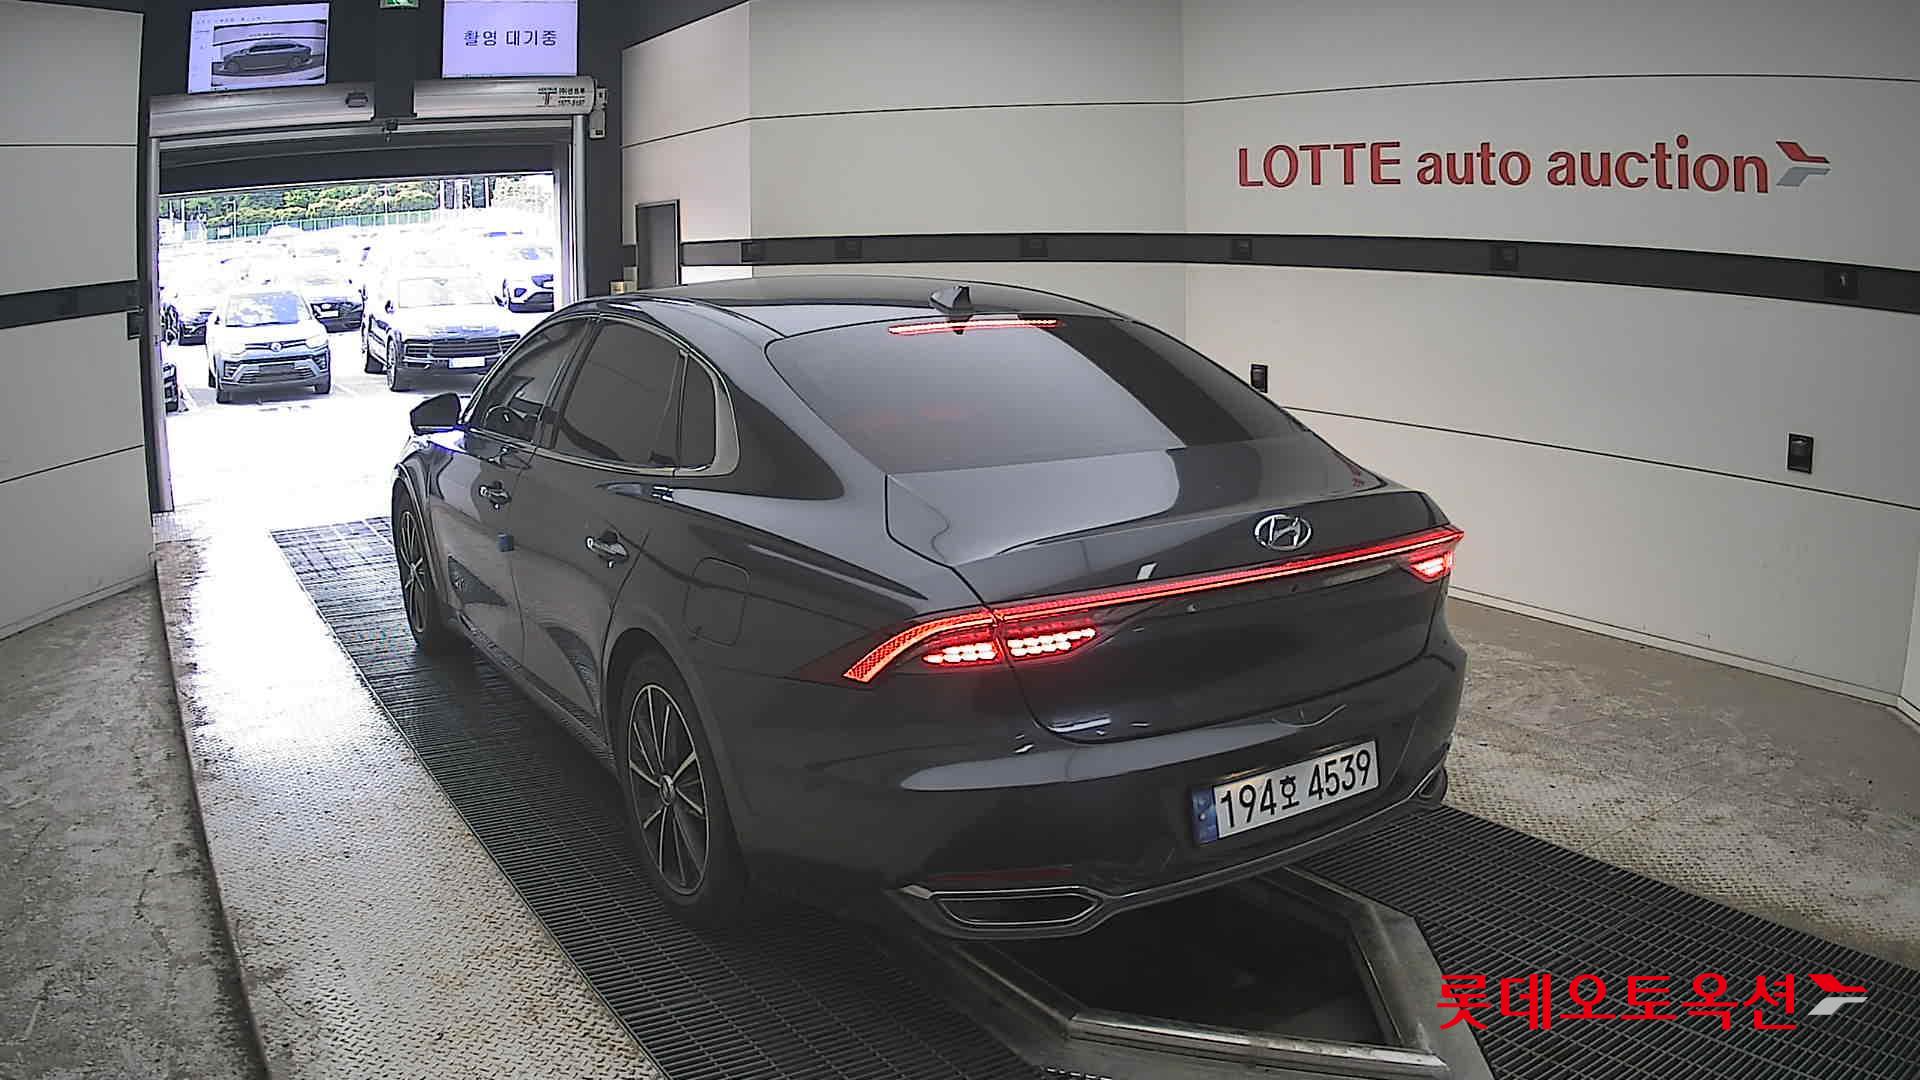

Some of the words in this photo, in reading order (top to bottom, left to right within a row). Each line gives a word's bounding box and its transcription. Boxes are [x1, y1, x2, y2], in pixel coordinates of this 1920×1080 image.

[464, 30, 497, 46] 촬영
[505, 30, 557, 46] 대기중
[1238, 141, 1401, 188] LOTTE
[1416, 141, 1532, 187] auto
[1546, 134, 1769, 194] auction
[1220, 775, 1300, 828] 194호
[1308, 749, 1371, 800] 4539
